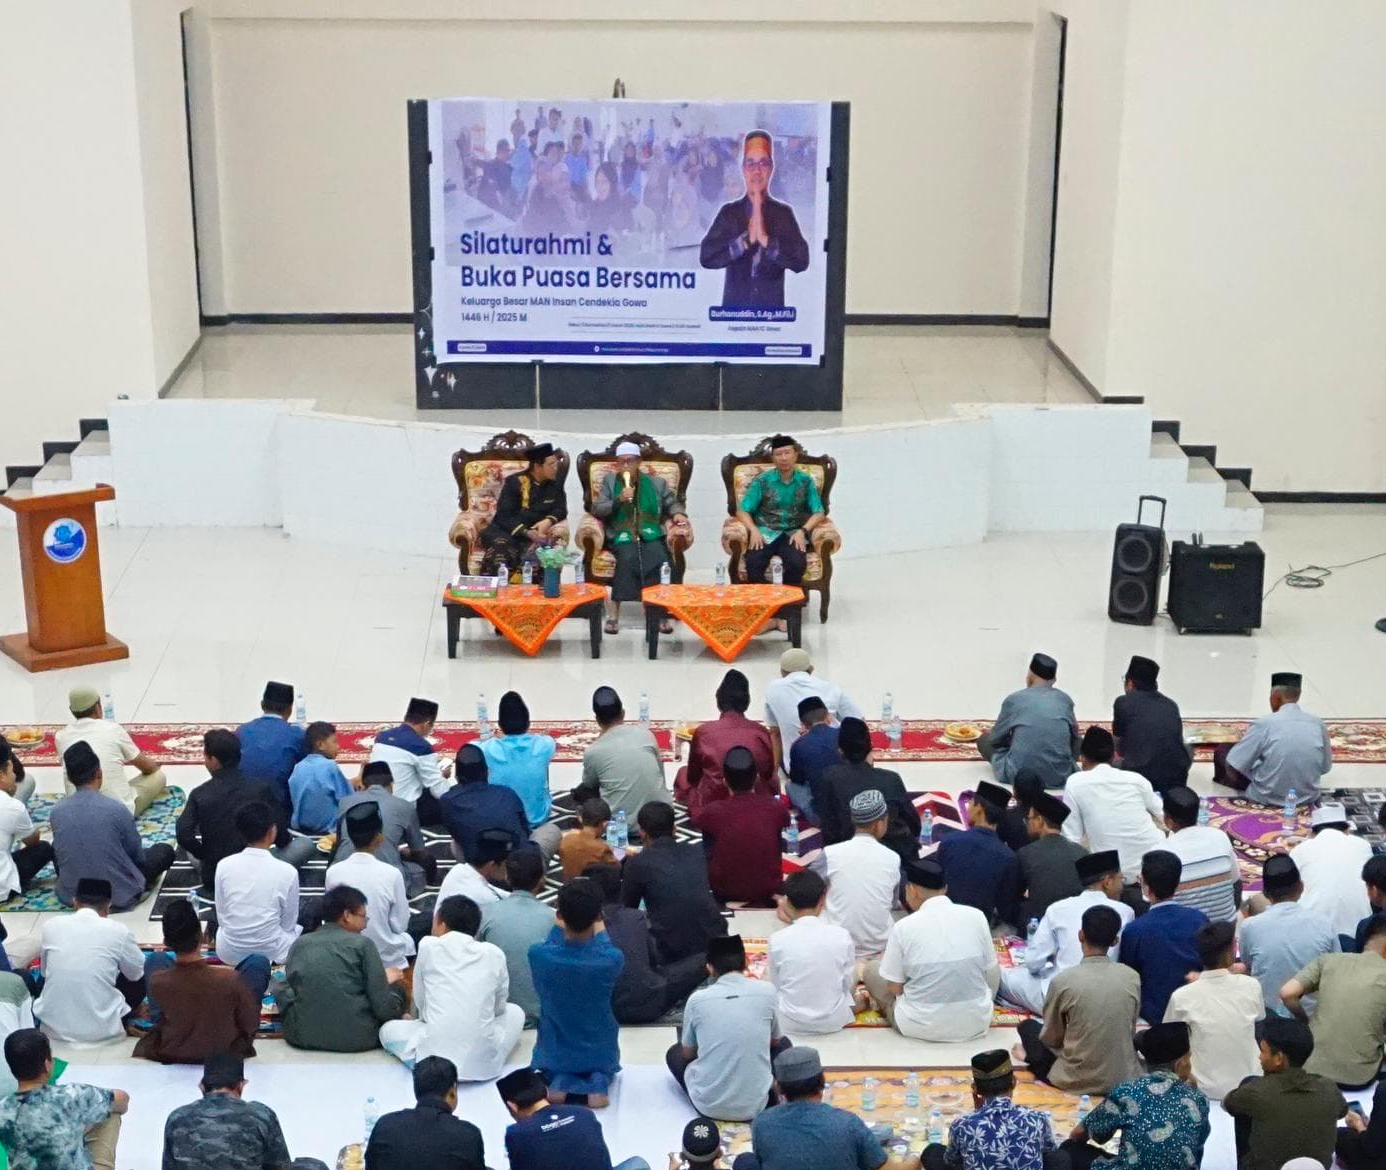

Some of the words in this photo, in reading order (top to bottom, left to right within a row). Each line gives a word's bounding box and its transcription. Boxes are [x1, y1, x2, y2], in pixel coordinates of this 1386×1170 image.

[460, 231, 591, 256] Silaturahmi
[597, 236, 613, 256] &
[461, 265, 516, 287] Buka
[522, 266, 590, 288] Puasa
[596, 267, 696, 289] Bersama
[461, 297, 502, 309] Keluarga
[503, 297, 528, 306] Besar
[530, 297, 551, 306] MAN
[552, 297, 577, 306] Insan
[578, 297, 621, 307] Cendekia
[622, 298, 648, 307] Gowa
[483, 313, 490, 322] H
[497, 313, 518, 322] 2025
[519, 313, 528, 322] M
